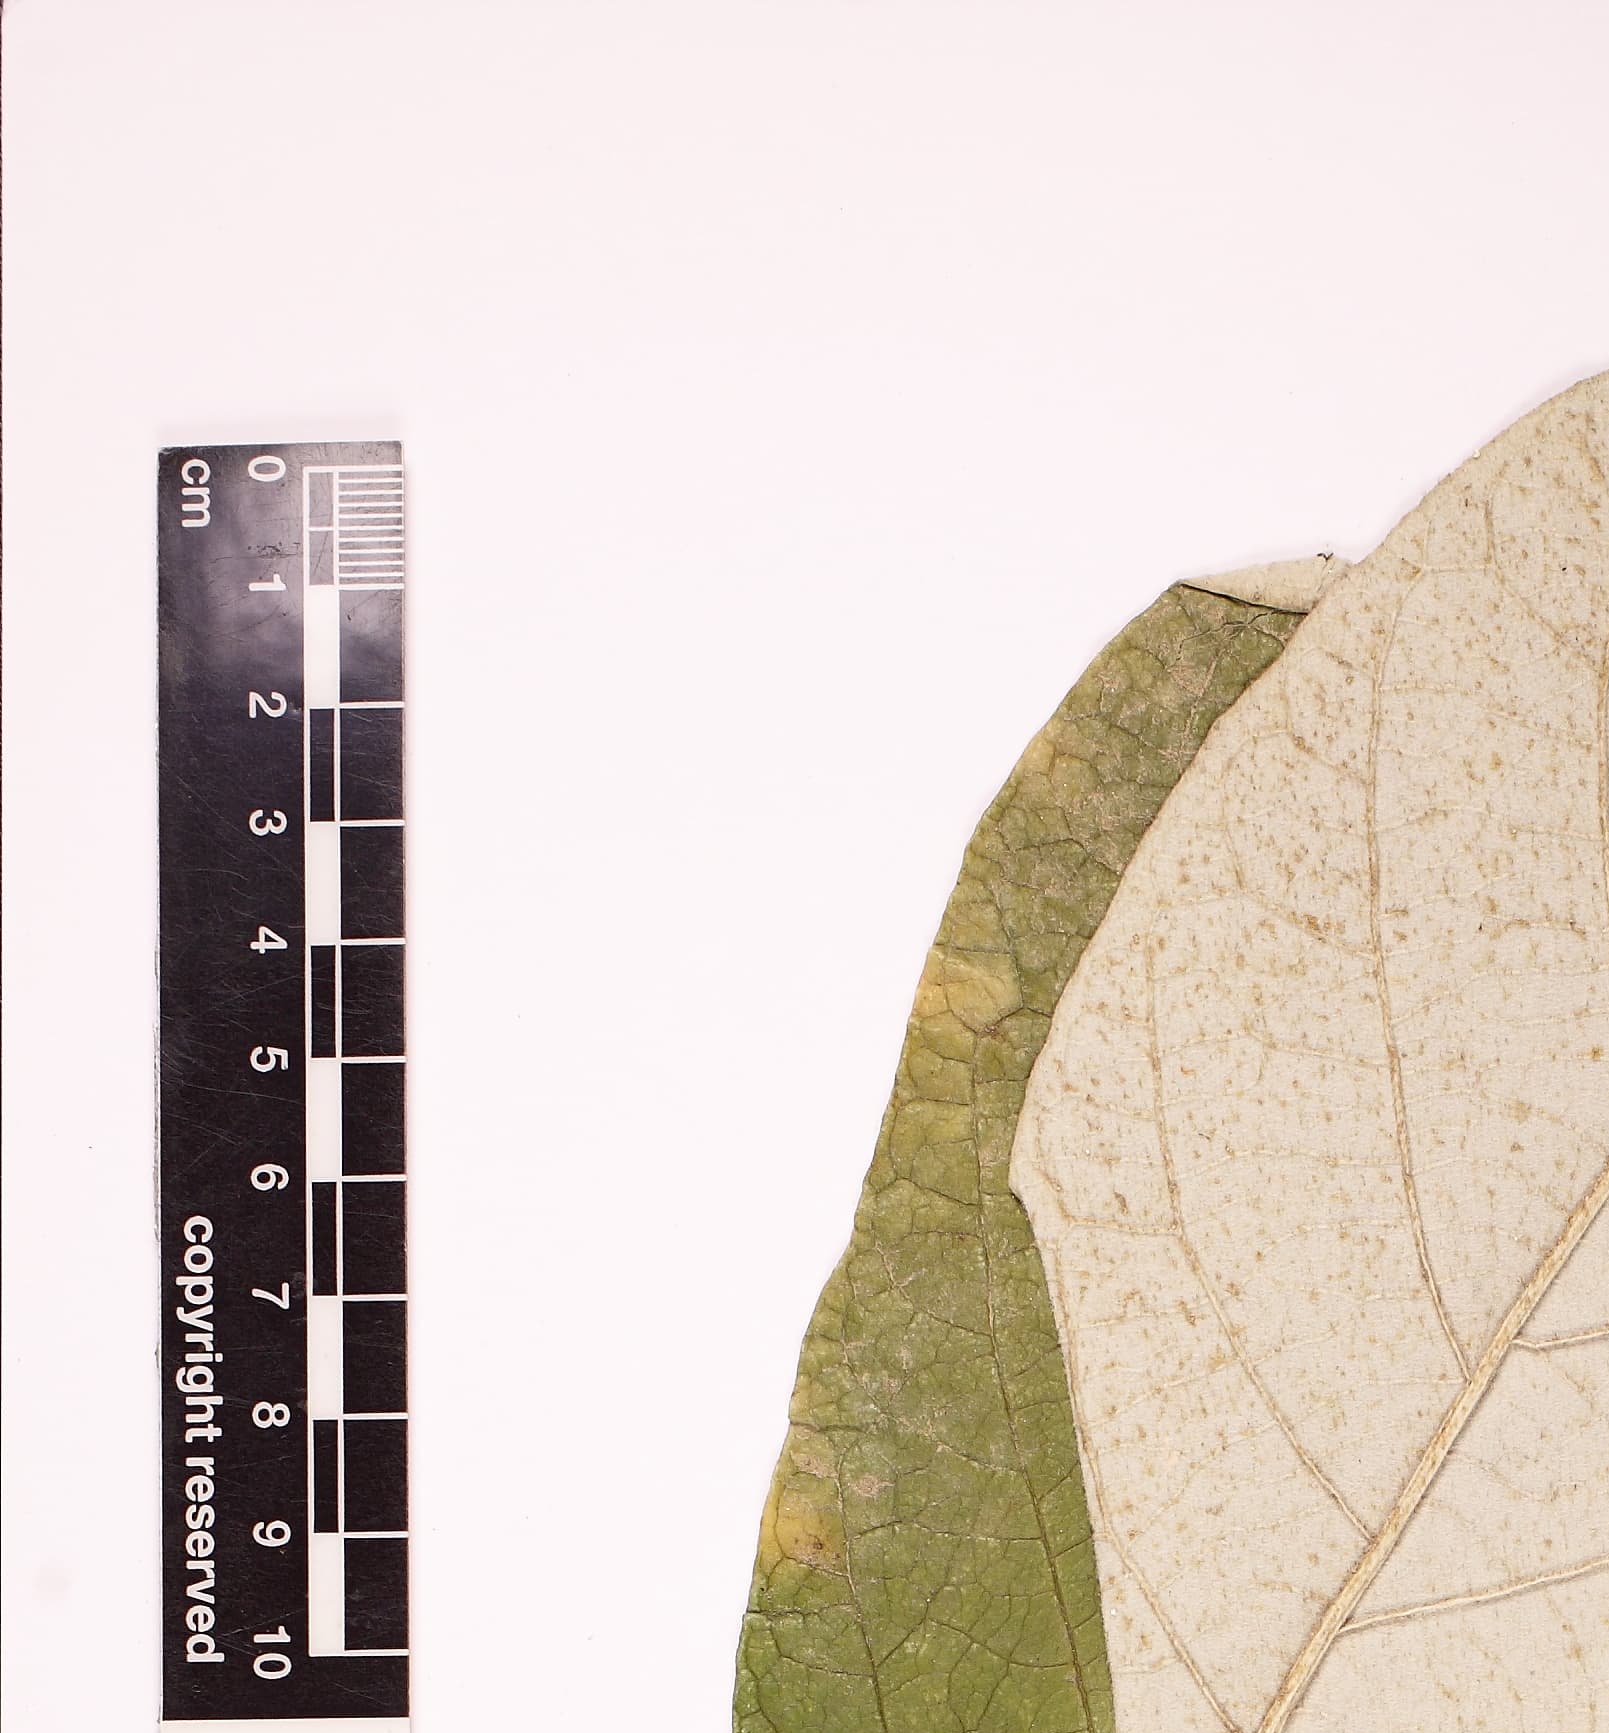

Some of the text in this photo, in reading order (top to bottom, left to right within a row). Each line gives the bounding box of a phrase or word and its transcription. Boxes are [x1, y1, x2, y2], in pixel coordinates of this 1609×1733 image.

[246, 455, 289, 482] 0
[180, 457, 212, 528] cm
[247, 573, 288, 592] 1
[248, 690, 288, 719] 2
[248, 809, 289, 837] 3
[248, 925, 289, 954] 4
[249, 1045, 290, 1073] 5
[249, 1162, 291, 1192] 6
[250, 1281, 291, 1310] 7
[251, 1401, 291, 1429] 8
[176, 1214, 225, 1664] copyright reserved
[252, 1519, 292, 1548] 9
[252, 1625, 292, 1680] 10
